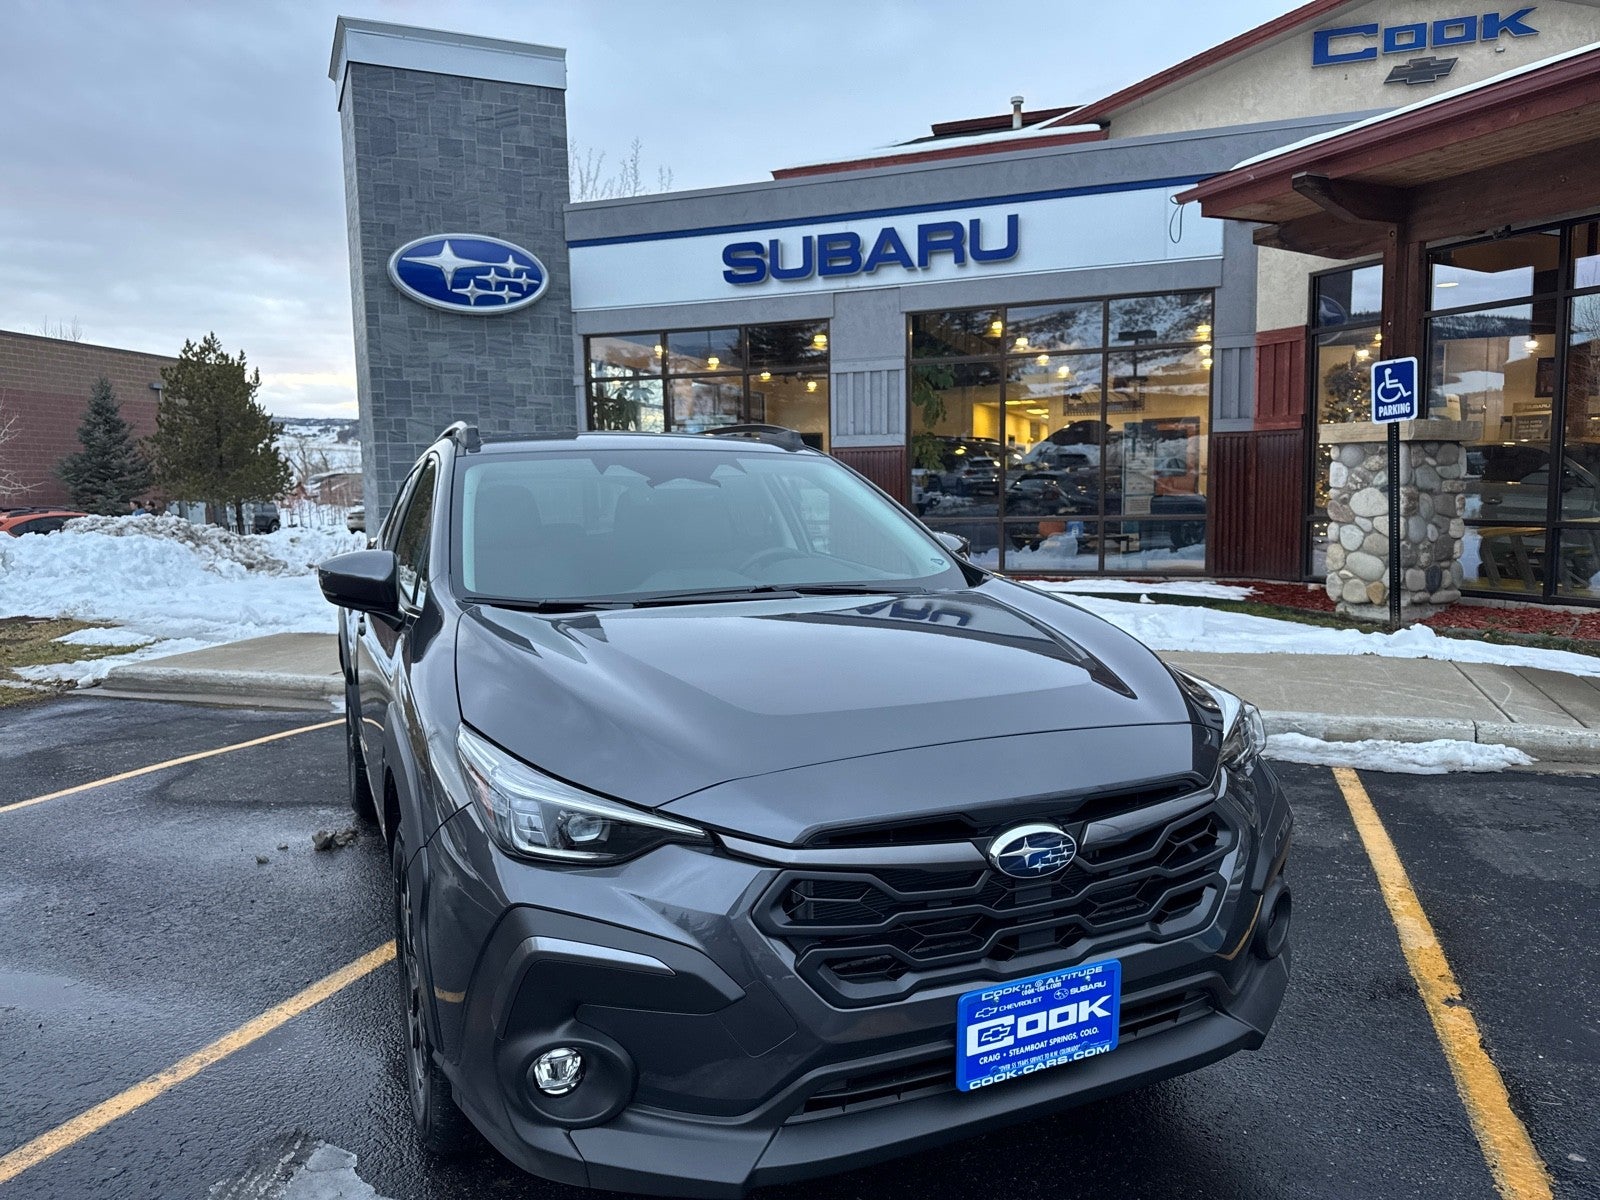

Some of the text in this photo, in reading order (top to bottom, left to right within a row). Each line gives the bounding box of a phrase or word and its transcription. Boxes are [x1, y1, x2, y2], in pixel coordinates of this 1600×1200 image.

[1311, 7, 1540, 68] COOK
[722, 213, 1020, 286] SUBARU
[1378, 402, 1411, 418] PARKING
[1045, 966, 1103, 985] ALTITUDE
[1069, 981, 1107, 995] SUBARU
[999, 996, 1043, 1012] CHEVROLET
[967, 995, 1112, 1057] COOK
[979, 1052, 1001, 1065] CRAIG
[1008, 1040, 1048, 1057] STEAMBOAT
[1049, 1032, 1079, 1046] SPRINGS,
[1080, 1026, 1100, 1037] COLO.
[969, 1044, 1110, 1090] COOK-CARS.COM
